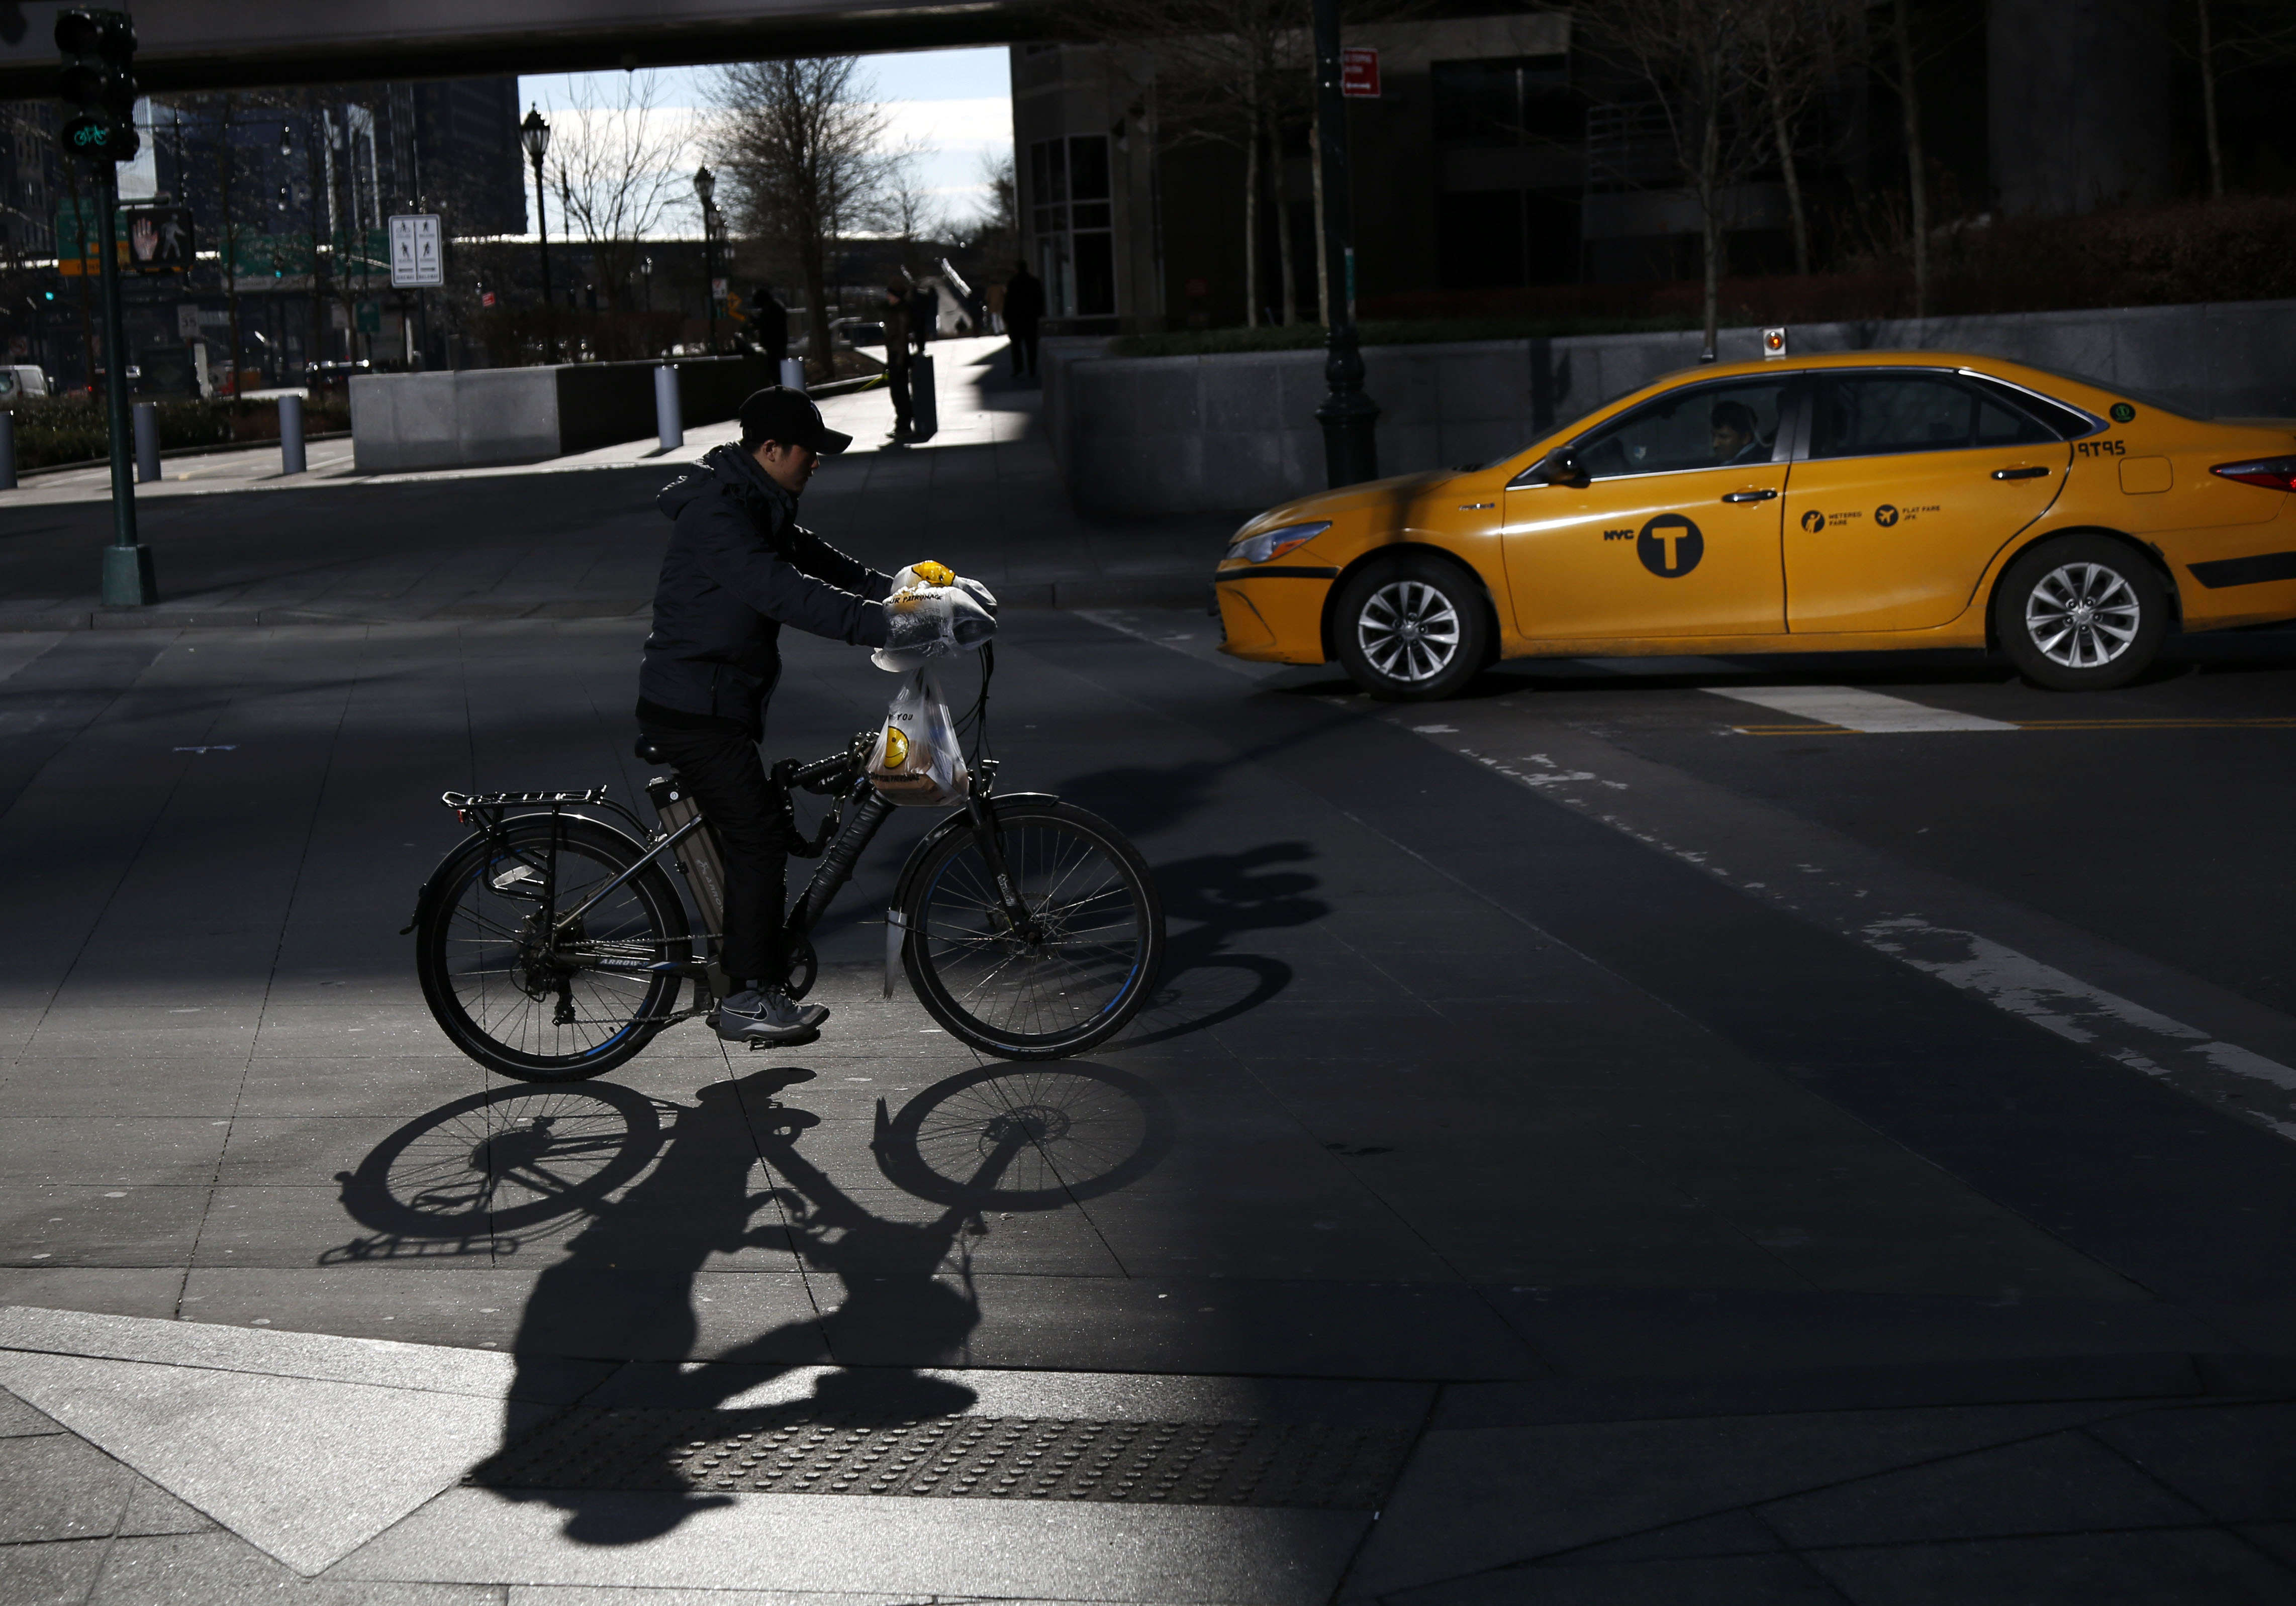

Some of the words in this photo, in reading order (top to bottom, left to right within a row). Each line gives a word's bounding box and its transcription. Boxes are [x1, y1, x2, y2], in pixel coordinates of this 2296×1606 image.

[2078, 440, 2126, 457] 9T95
[1829, 511, 1862, 520] METERED
[1603, 529, 1634, 541] NYC
[1651, 526, 1688, 570] T
[902, 594, 943, 604] PATRONAGE
